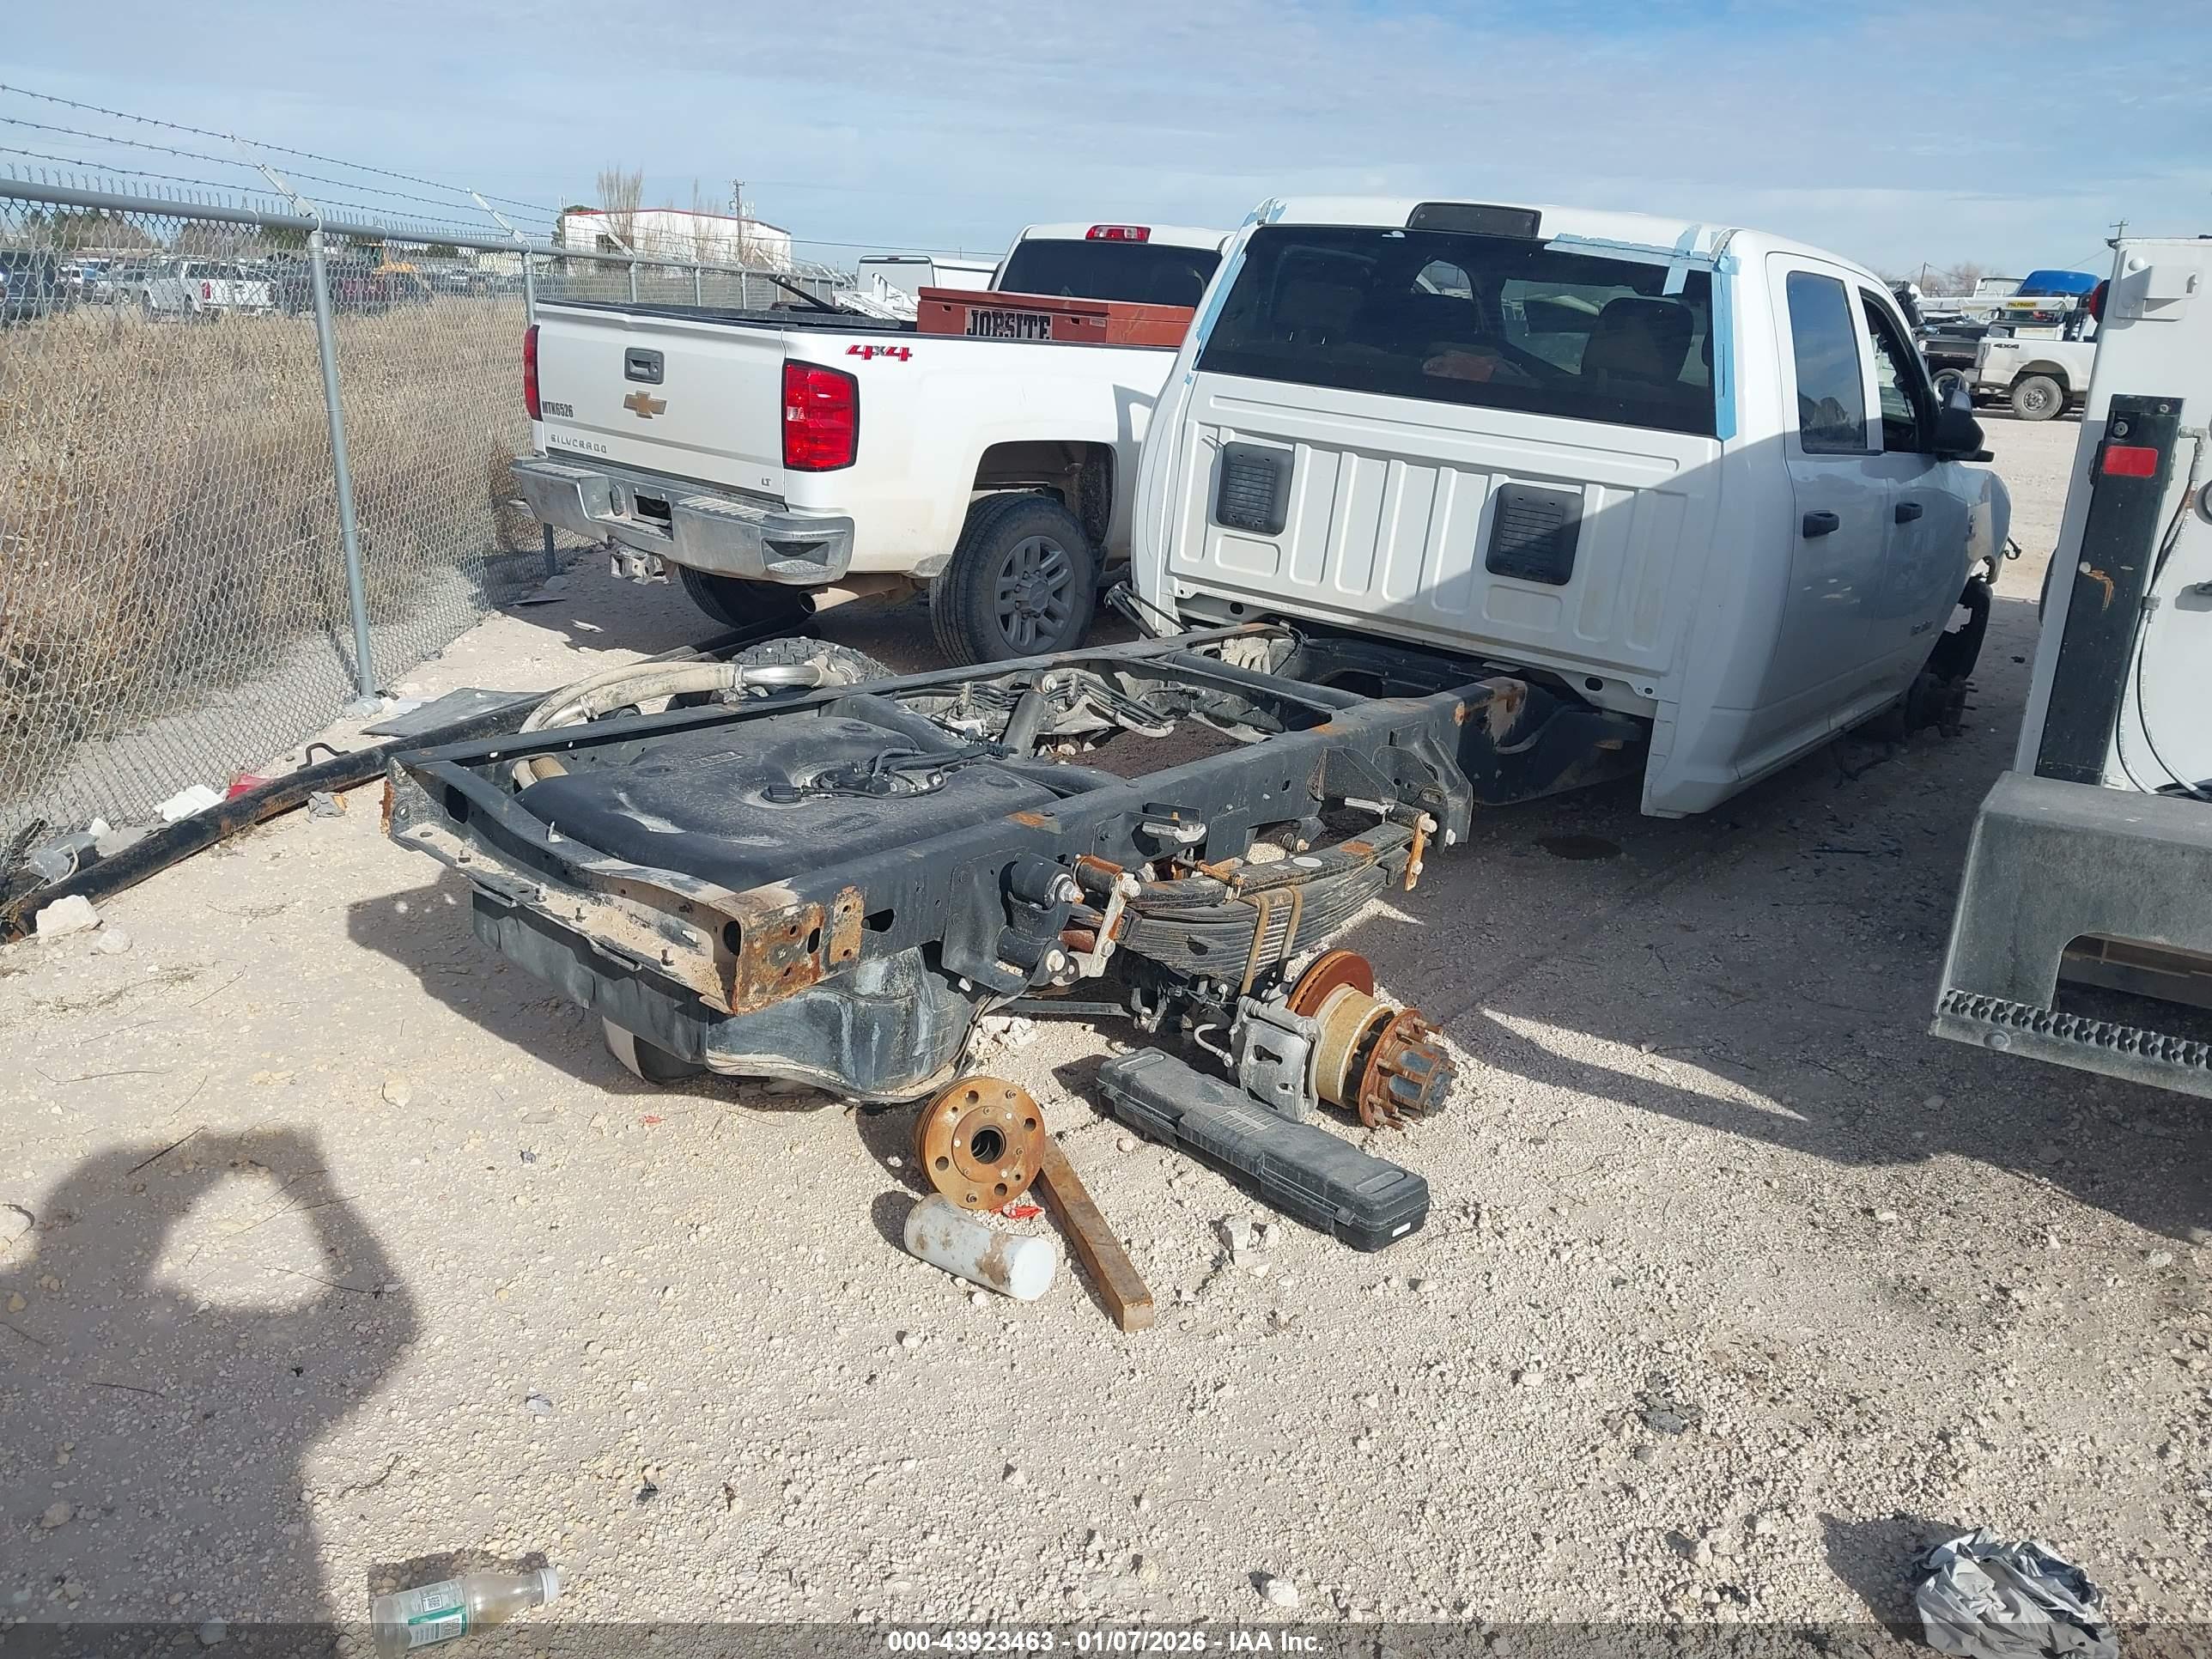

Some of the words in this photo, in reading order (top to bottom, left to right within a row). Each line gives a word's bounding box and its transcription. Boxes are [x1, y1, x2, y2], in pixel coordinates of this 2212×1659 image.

[967, 310, 1050, 339] JOBSITE
[550, 434, 607, 453] SILVERADO
[762, 477, 771, 487] LT
